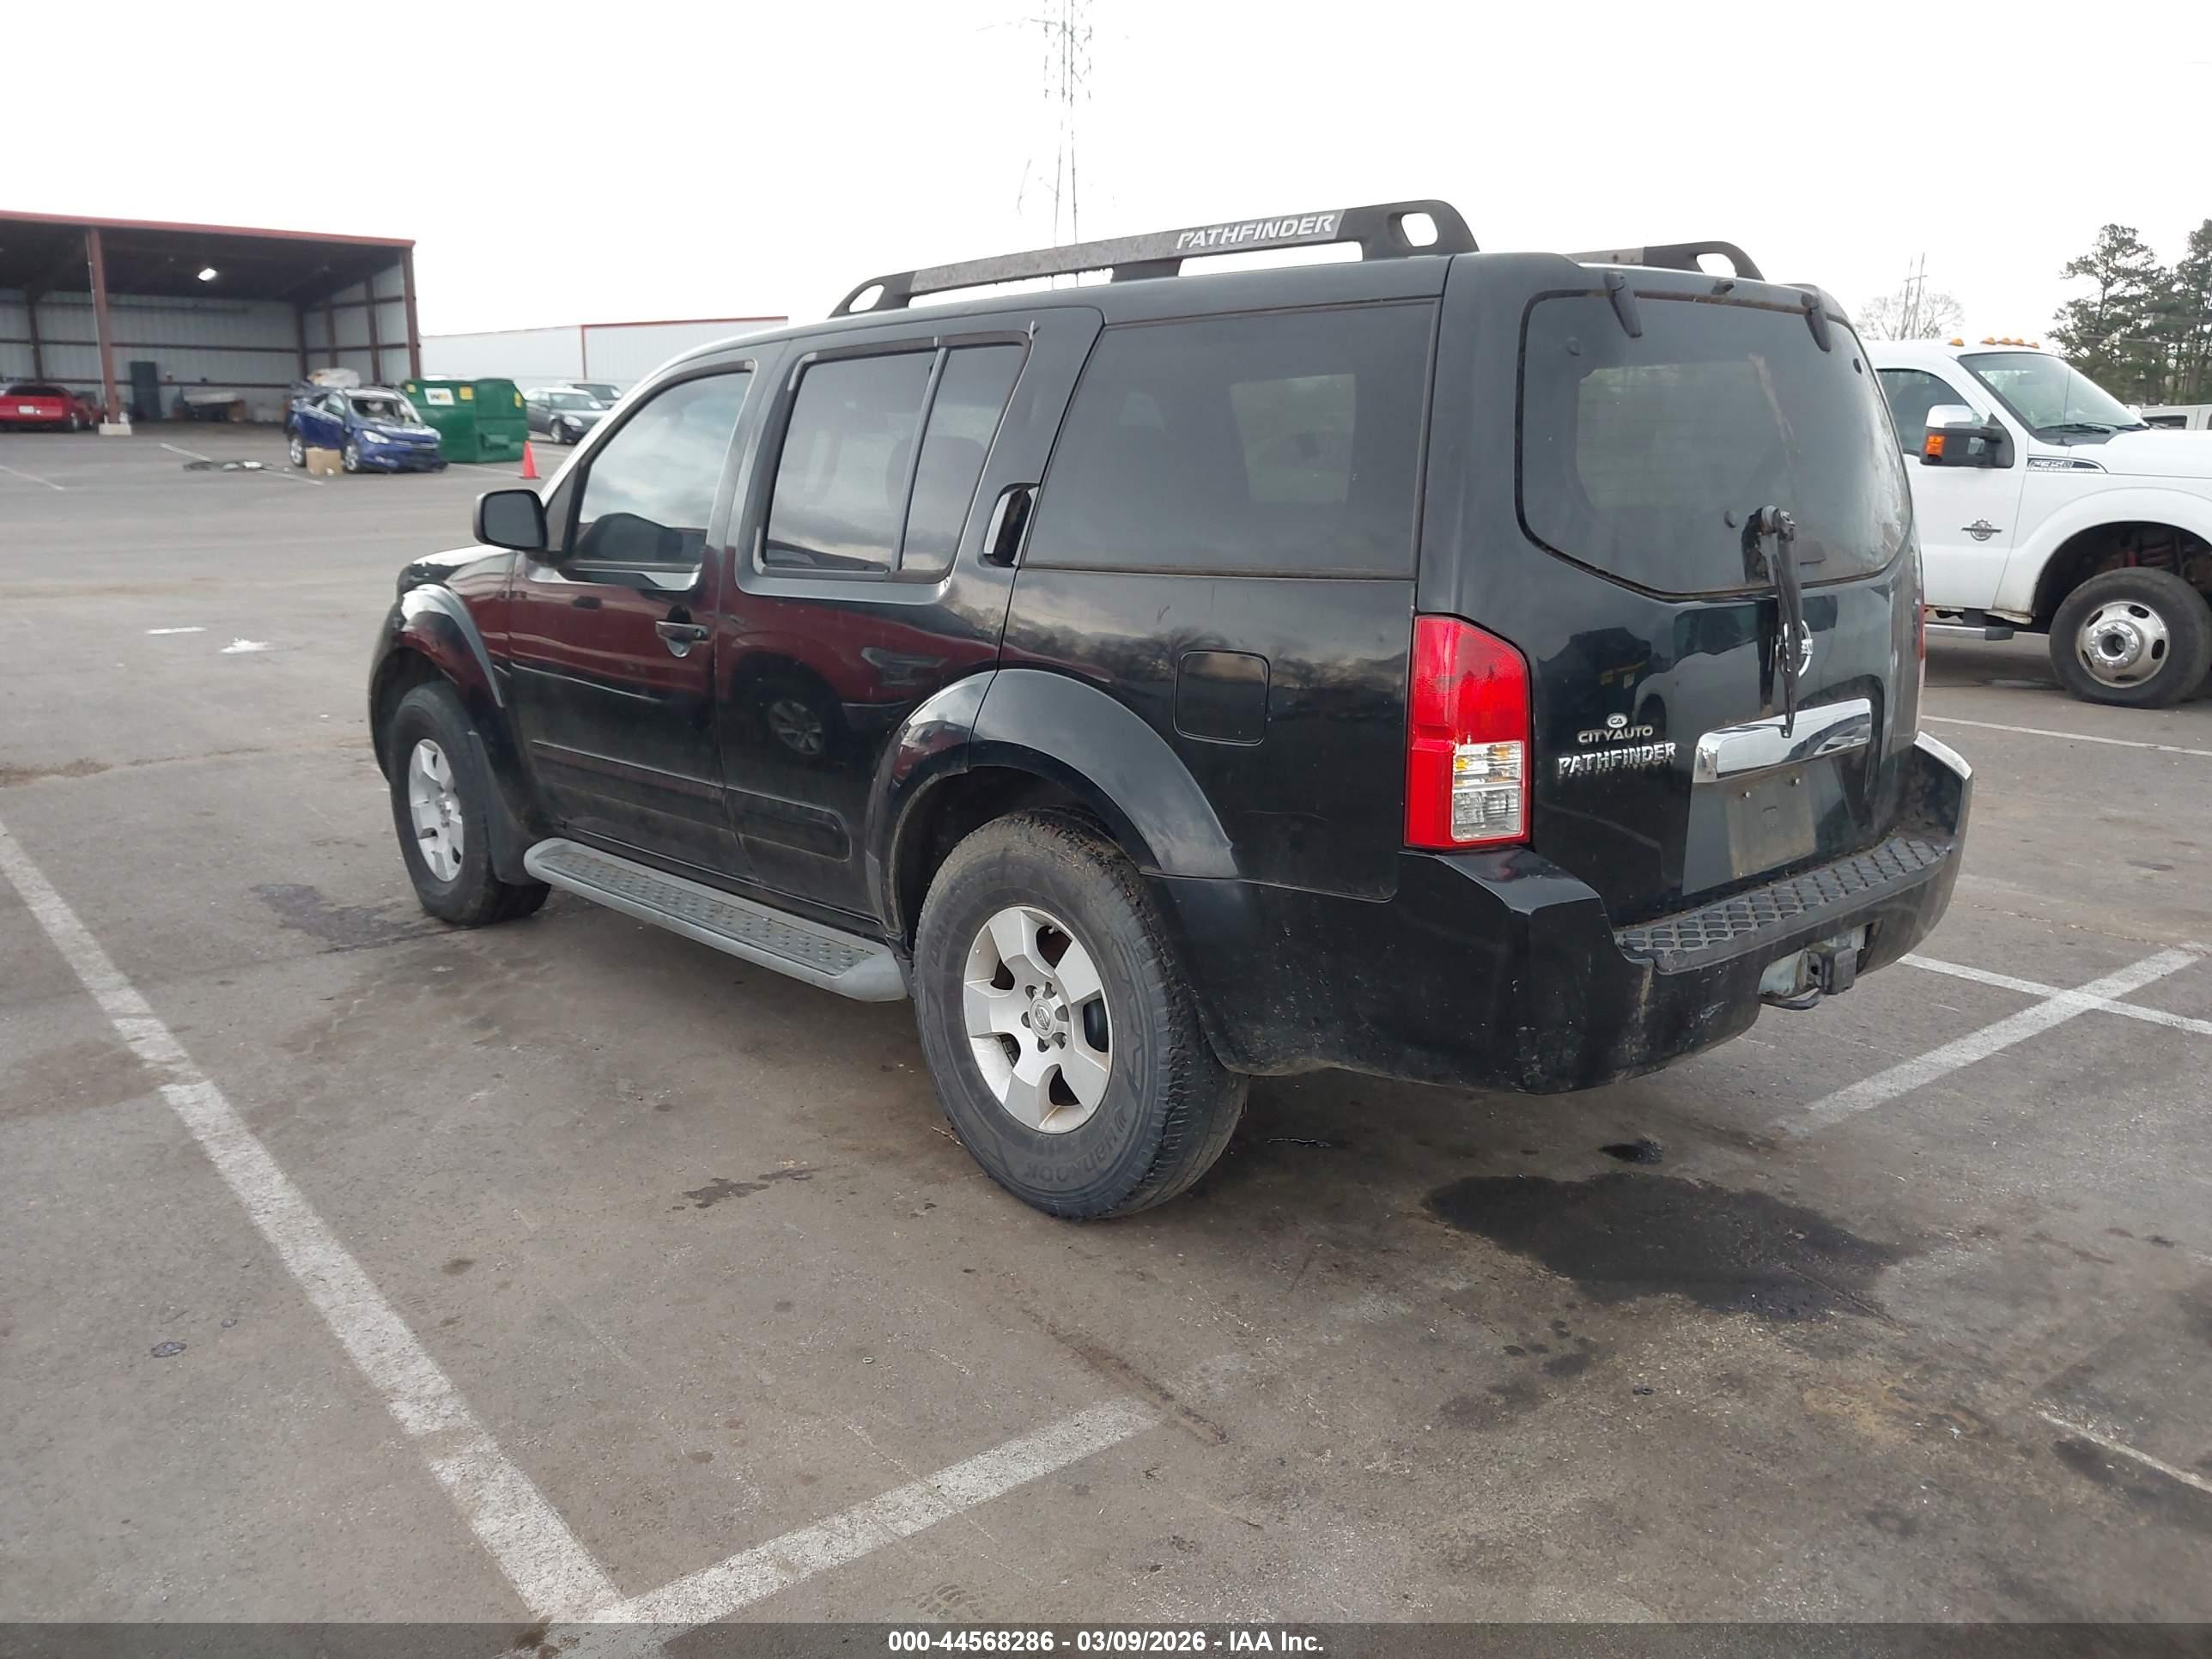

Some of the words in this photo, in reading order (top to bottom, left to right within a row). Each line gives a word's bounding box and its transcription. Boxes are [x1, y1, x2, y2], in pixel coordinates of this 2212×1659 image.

[1176, 215, 1335, 250] PATHFINDER
[1577, 726, 1654, 743] CITYAUTO
[1558, 742, 1677, 775] PATHFINDER
